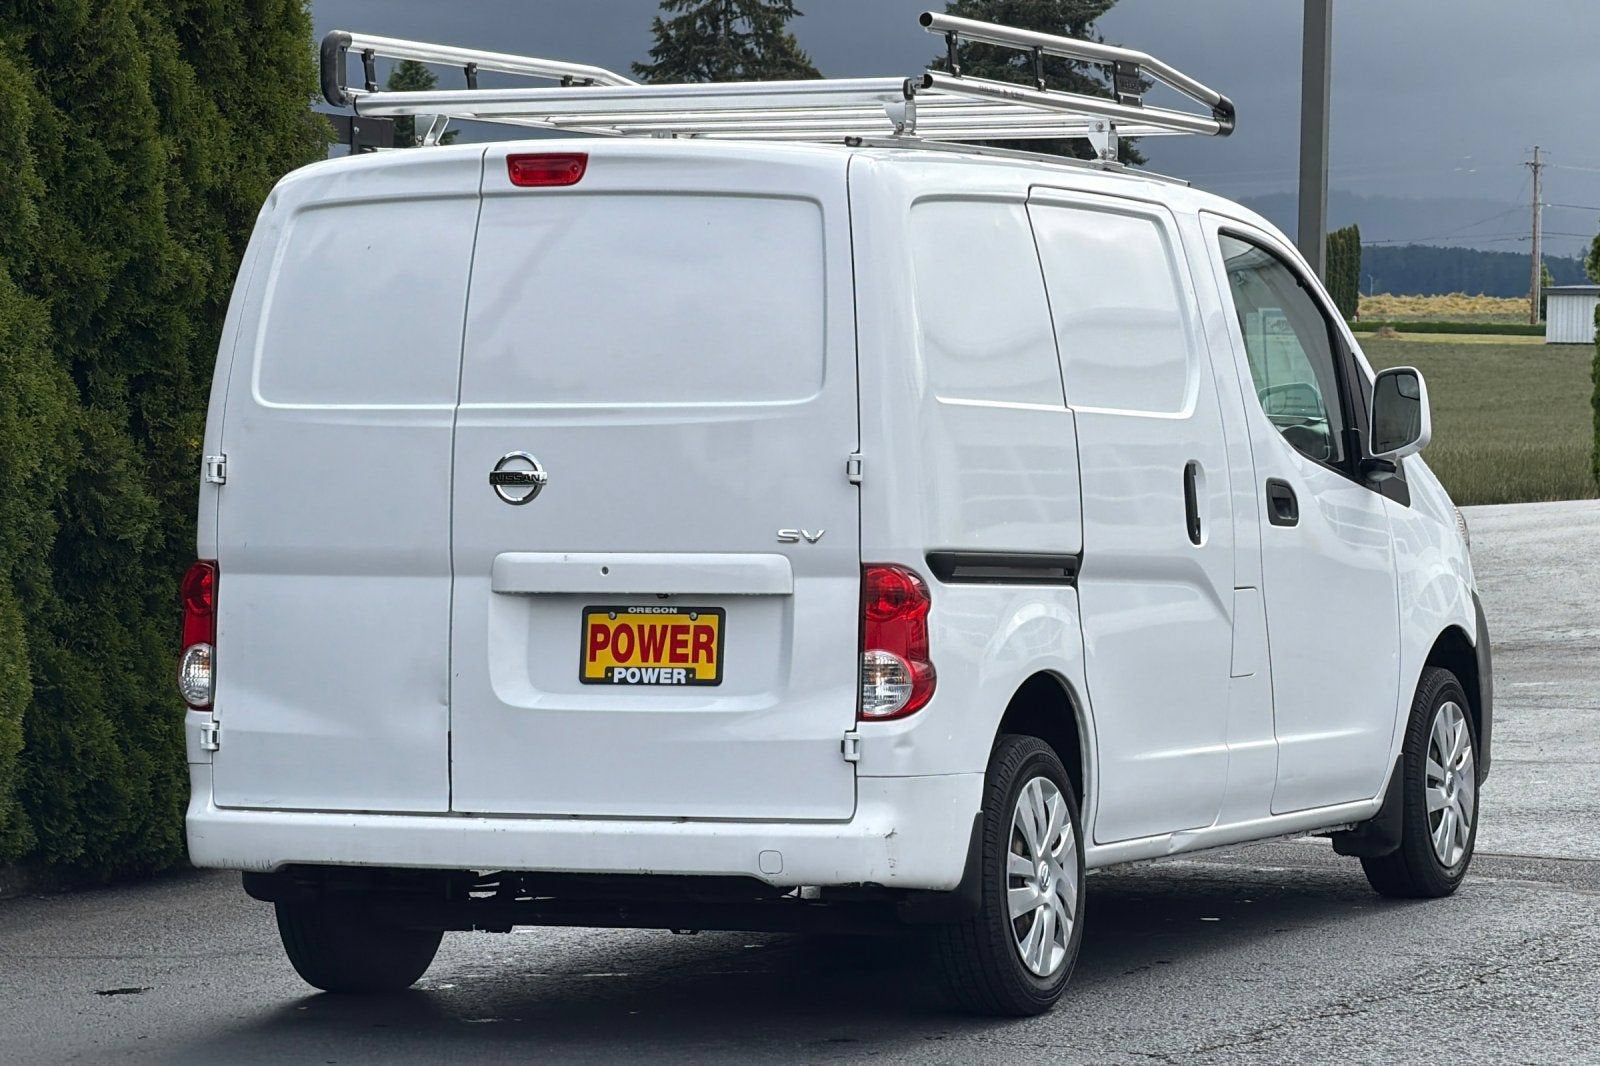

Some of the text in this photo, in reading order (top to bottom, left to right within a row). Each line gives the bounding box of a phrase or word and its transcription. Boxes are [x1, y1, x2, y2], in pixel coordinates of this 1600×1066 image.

[494, 473, 541, 482] NISSAN
[777, 529, 825, 544] SV
[589, 623, 715, 664] POWER
[613, 667, 687, 684] POWER
